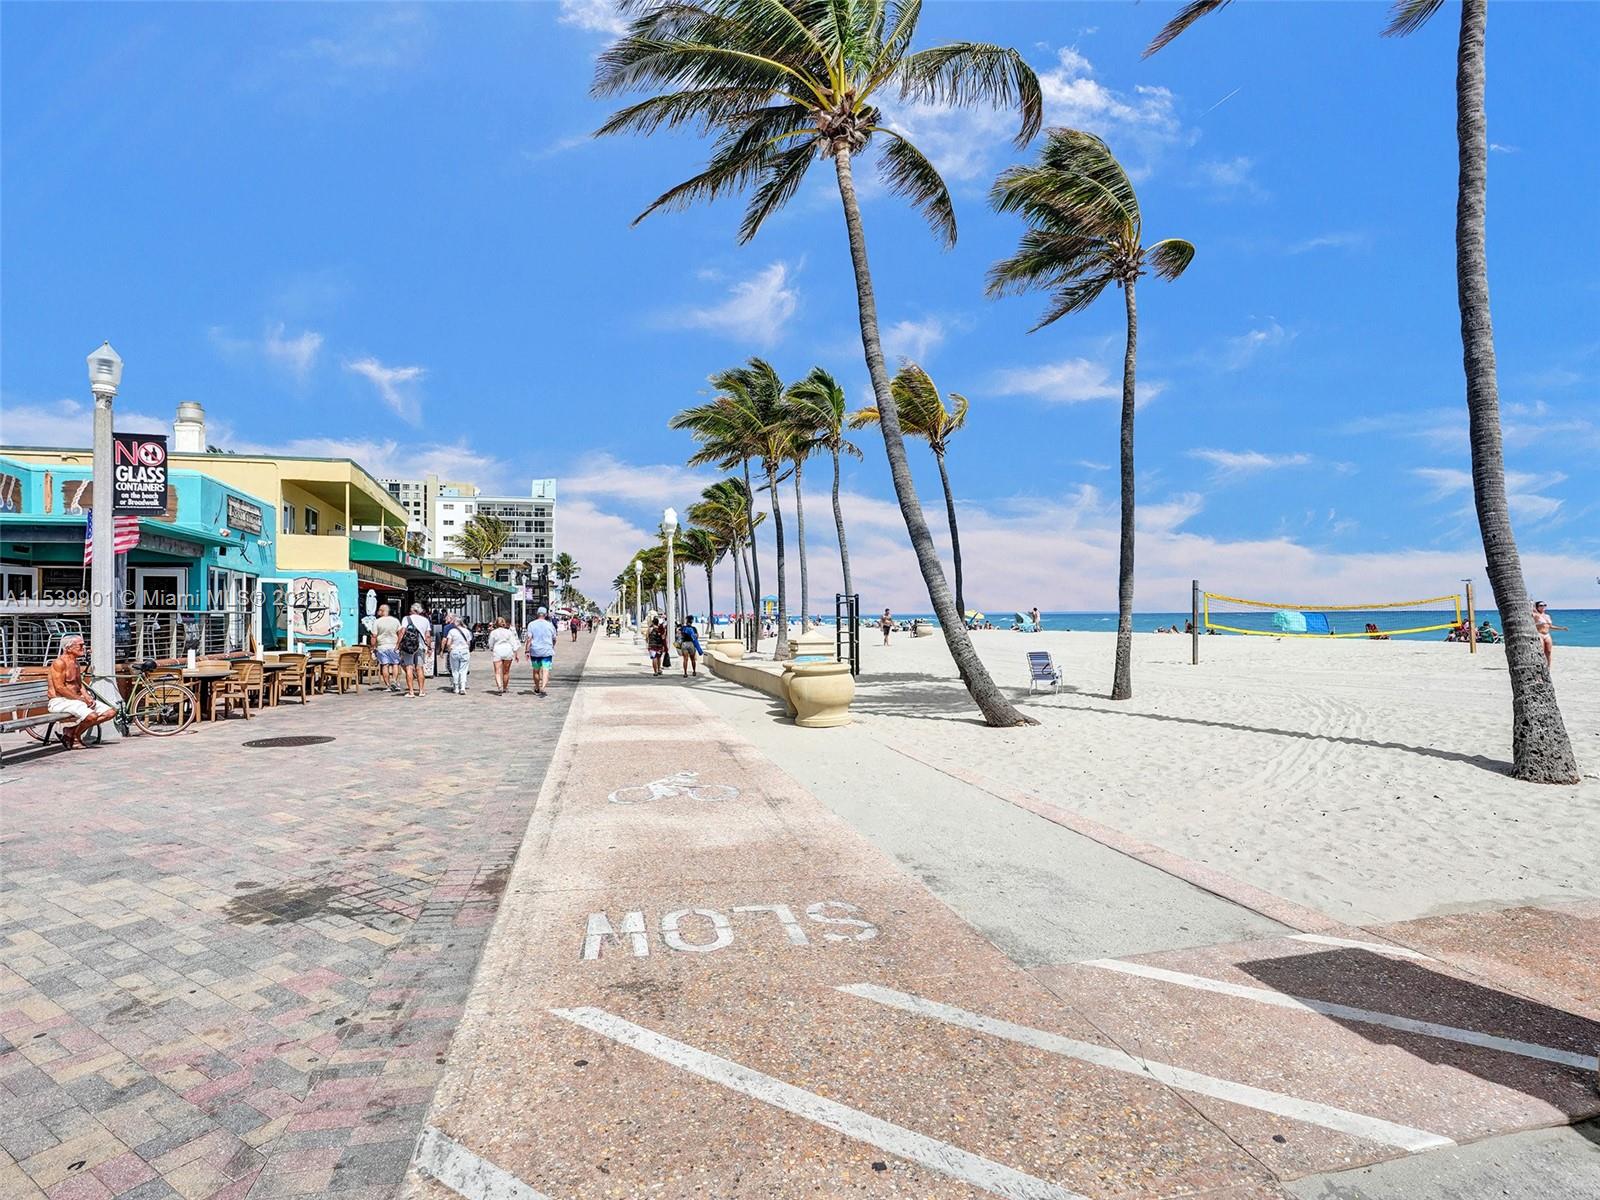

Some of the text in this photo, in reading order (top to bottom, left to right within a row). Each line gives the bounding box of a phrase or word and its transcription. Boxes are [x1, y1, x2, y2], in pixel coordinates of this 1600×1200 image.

[115, 440, 165, 466] NO
[115, 465, 165, 483] GLASS
[115, 482, 165, 492] CONTAINERS
[580, 901, 879, 960] SLOW
